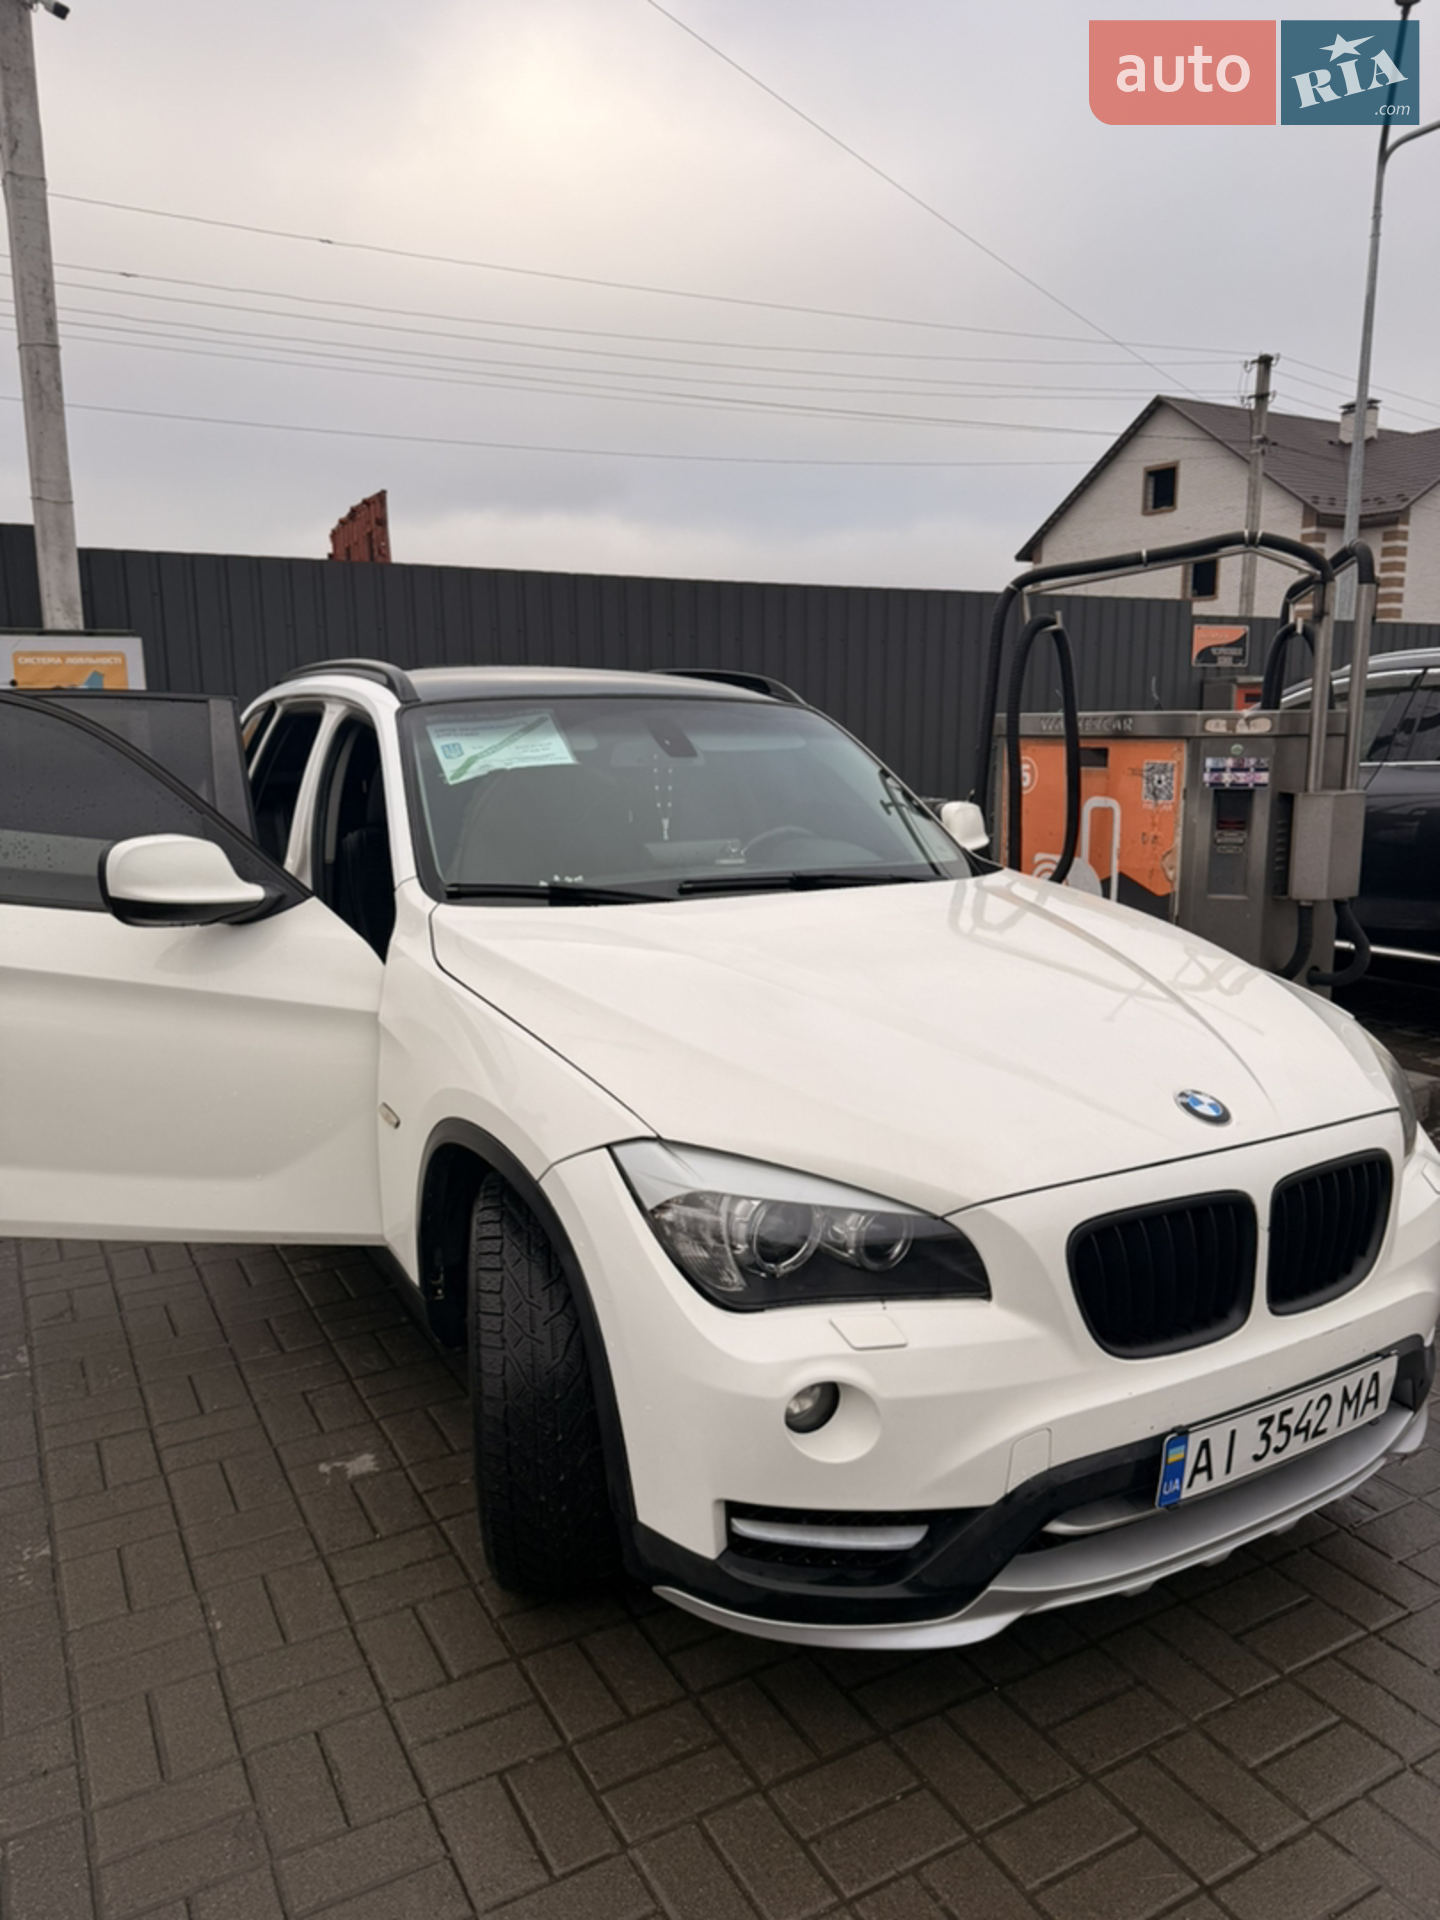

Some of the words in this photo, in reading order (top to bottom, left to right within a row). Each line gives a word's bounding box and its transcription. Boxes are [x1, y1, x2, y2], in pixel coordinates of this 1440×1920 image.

[1186, 1428, 1237, 1490] AI
[1252, 1392, 1333, 1463] 3542
[1336, 1370, 1381, 1429] MA
[1162, 1478, 1181, 1496] UA
